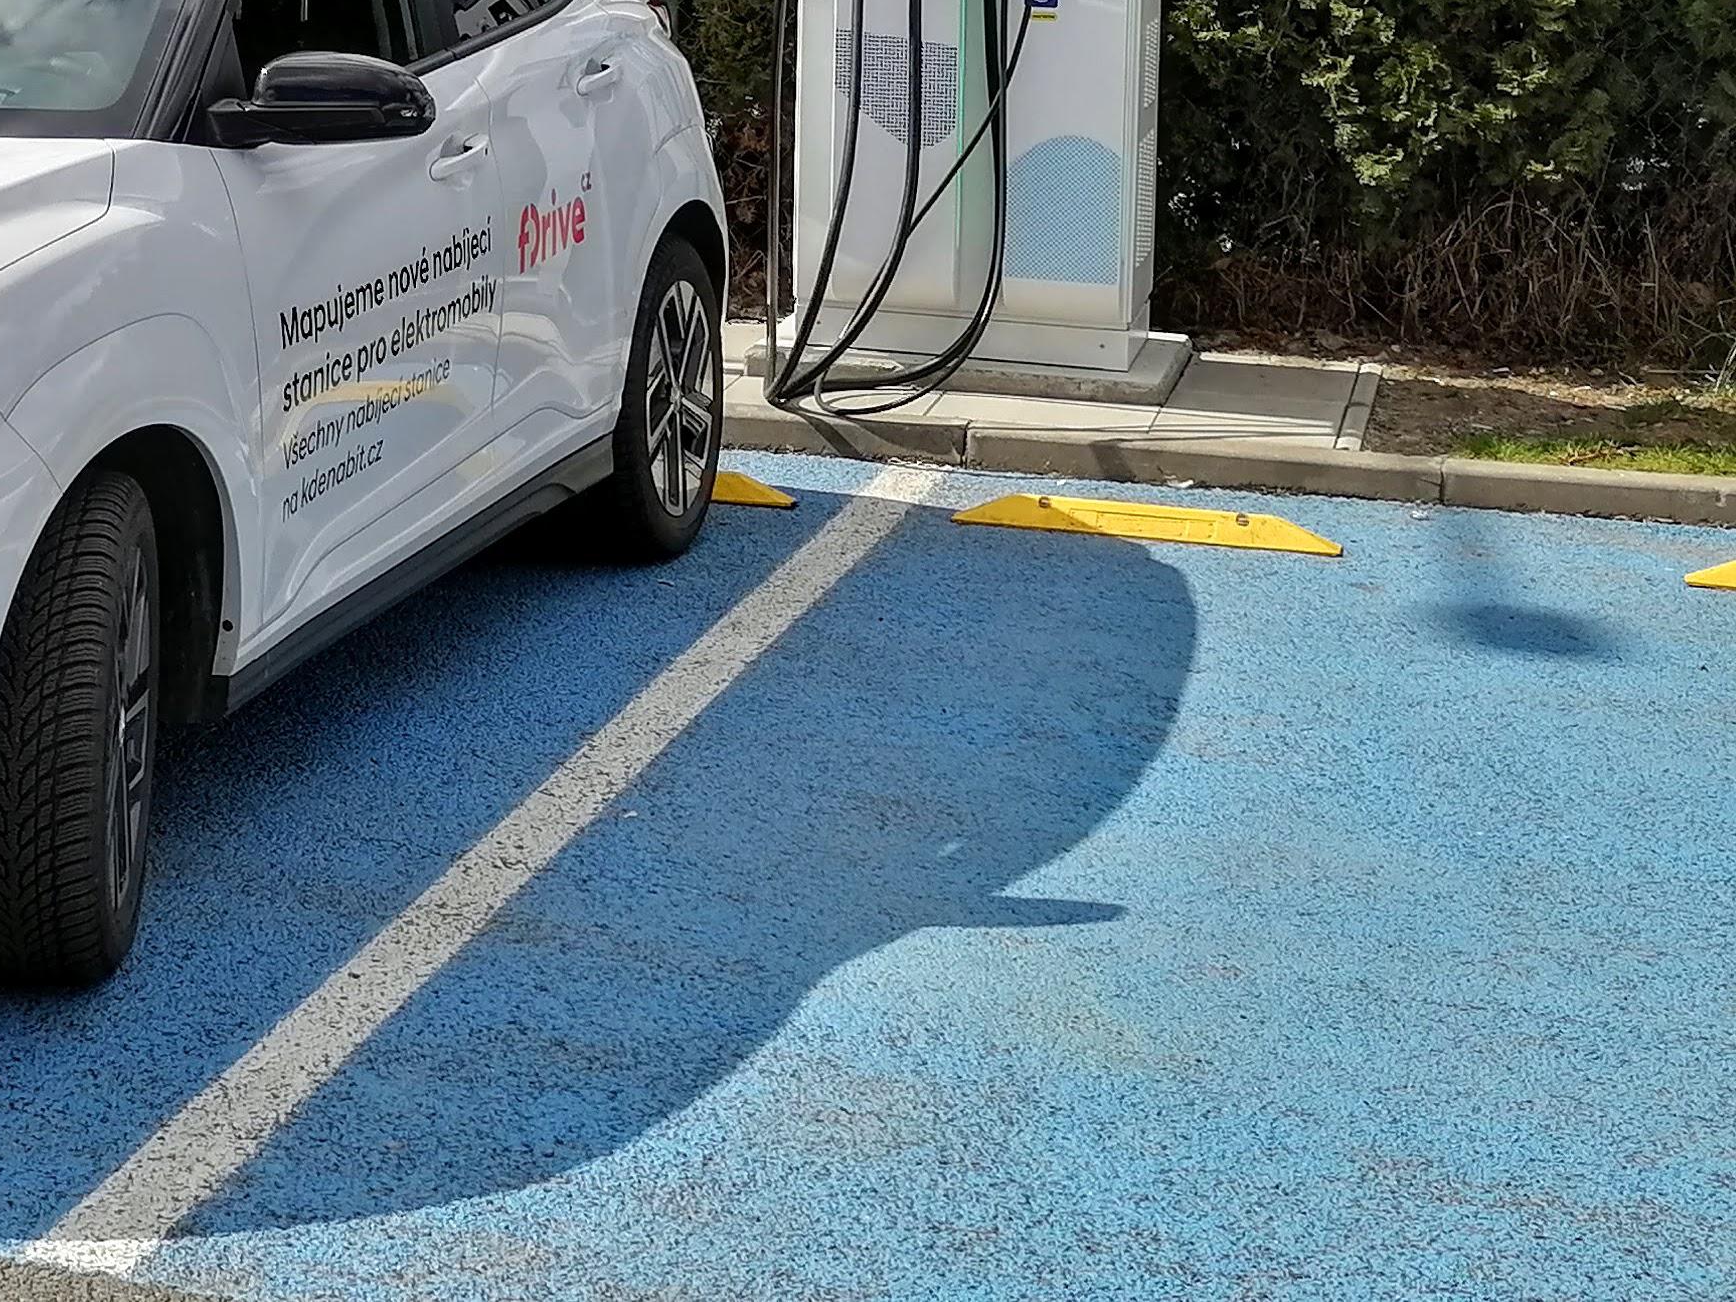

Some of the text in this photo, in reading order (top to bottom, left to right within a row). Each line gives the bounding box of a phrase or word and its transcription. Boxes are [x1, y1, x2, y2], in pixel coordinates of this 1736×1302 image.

[280, 216, 492, 349] Mapujeme nové nabíjecí
[282, 274, 497, 412] stanice pro elektromobily
[347, 376, 403, 435] nabíjecí
[404, 357, 451, 402] stanice
[282, 439, 384, 523] na kdenabit.cz
